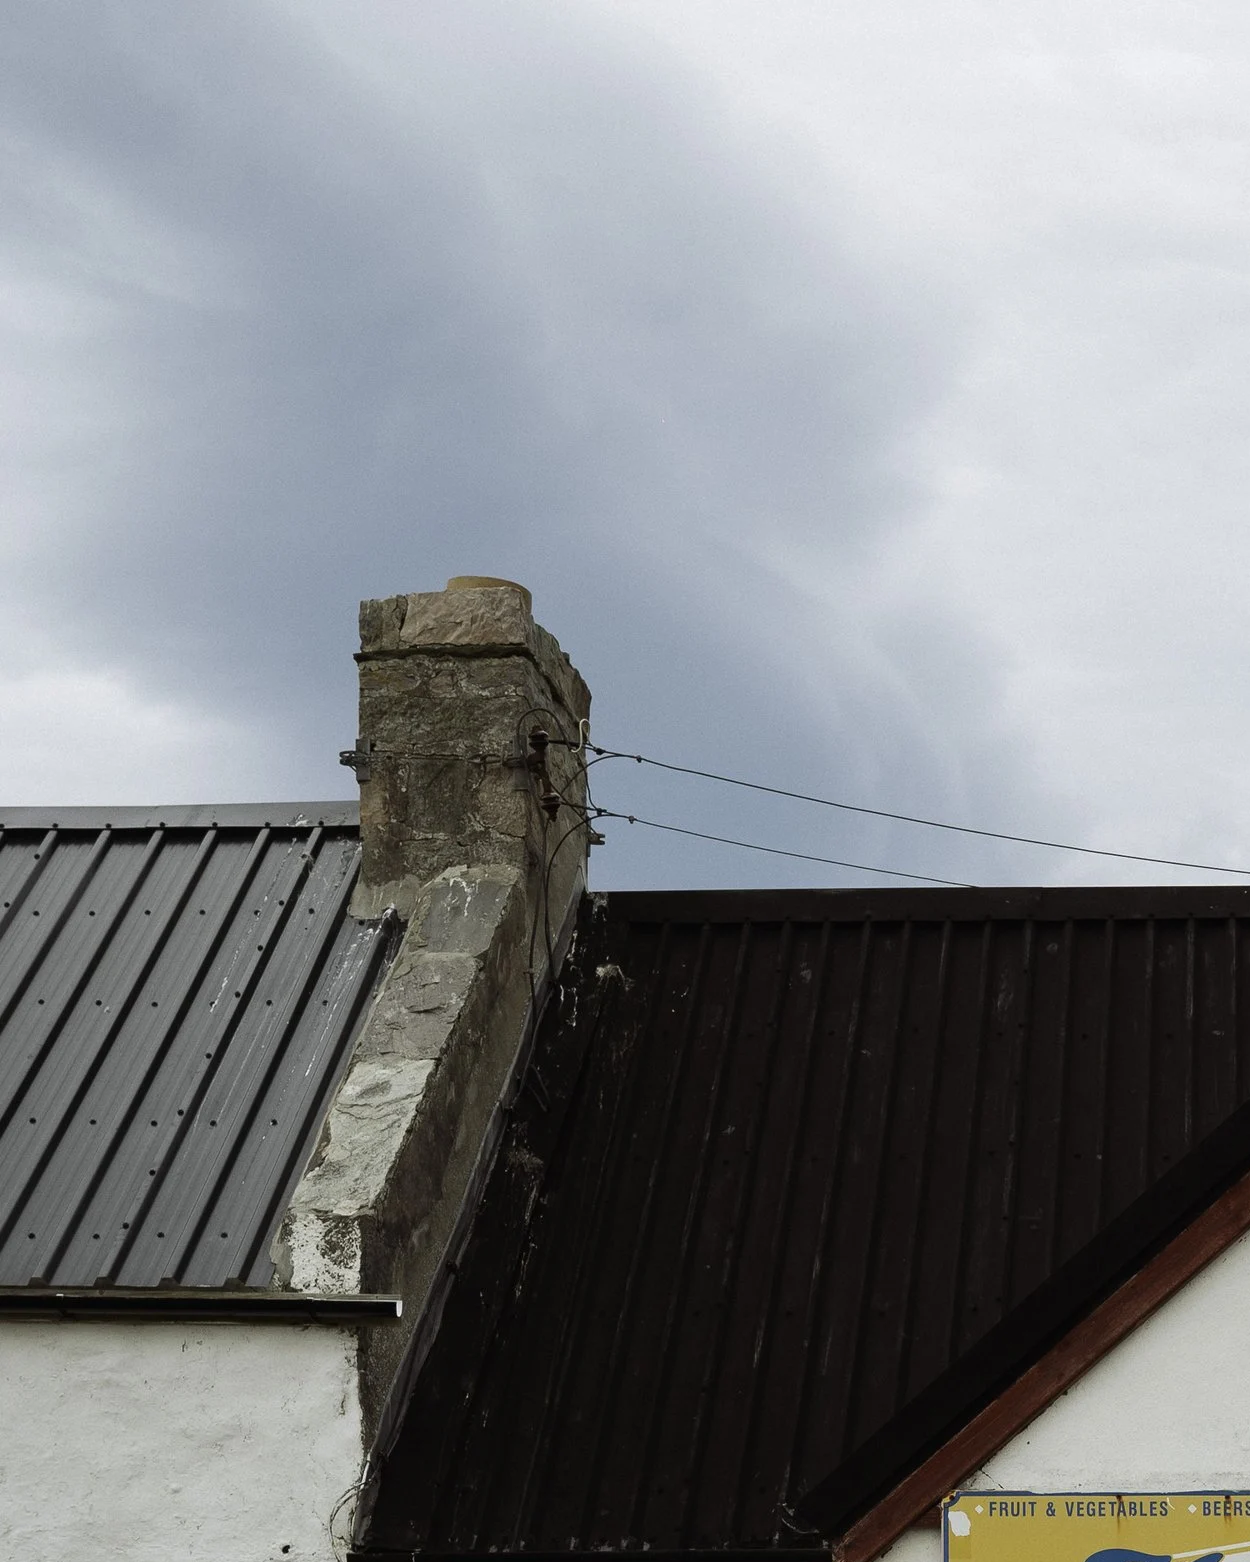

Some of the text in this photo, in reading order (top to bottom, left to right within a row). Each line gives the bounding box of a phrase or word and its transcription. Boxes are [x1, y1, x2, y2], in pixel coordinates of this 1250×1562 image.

[988, 1500, 1169, 1517] FRUIT & VEGETABLES
